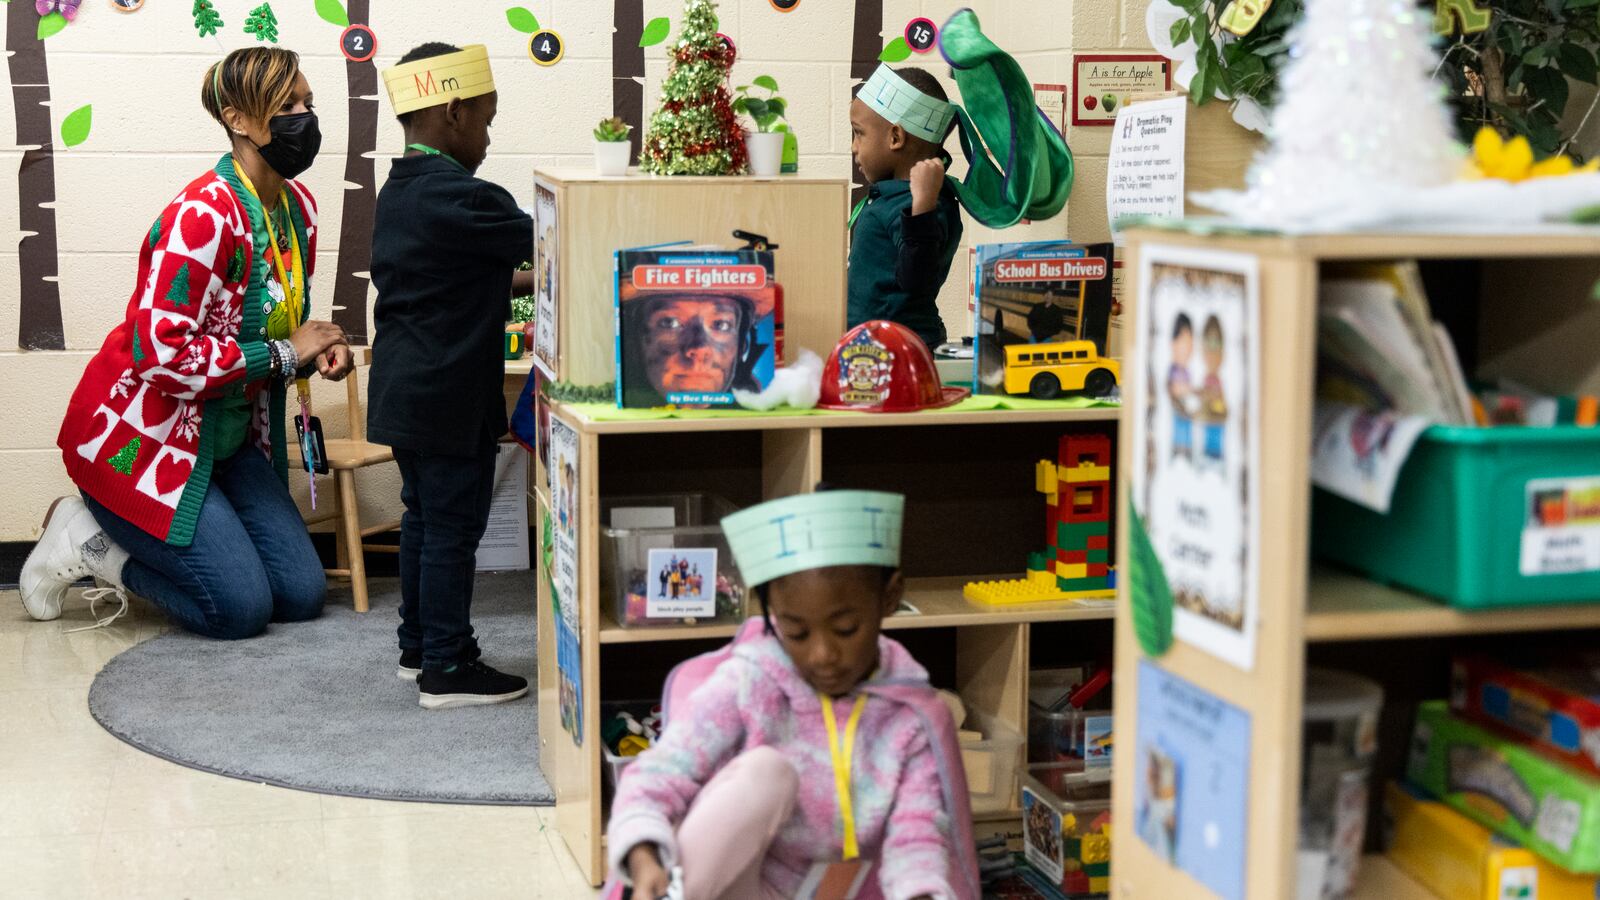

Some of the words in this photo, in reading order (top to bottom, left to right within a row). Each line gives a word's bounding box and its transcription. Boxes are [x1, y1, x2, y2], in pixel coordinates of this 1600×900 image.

[914, 26, 930, 43] 15
[353, 36, 364, 50] 2
[541, 40, 552, 54] 4
[1091, 66, 1098, 77] A
[1102, 68, 1109, 77] is
[1113, 66, 1126, 77] for
[1129, 65, 1153, 82] Apple
[414, 70, 438, 97] M
[1137, 116, 1159, 126] Dramatic
[1161, 115, 1173, 126] Play
[1141, 127, 1167, 138] Questions
[665, 257, 704, 265] Community
[706, 257, 733, 265] Helpers
[997, 263, 1036, 278] School
[1039, 263, 1061, 277] Bus
[1063, 262, 1104, 277] Drivers
[646, 268, 680, 284] Fire
[685, 268, 757, 288] Fighters
[670, 395, 681, 404] by
